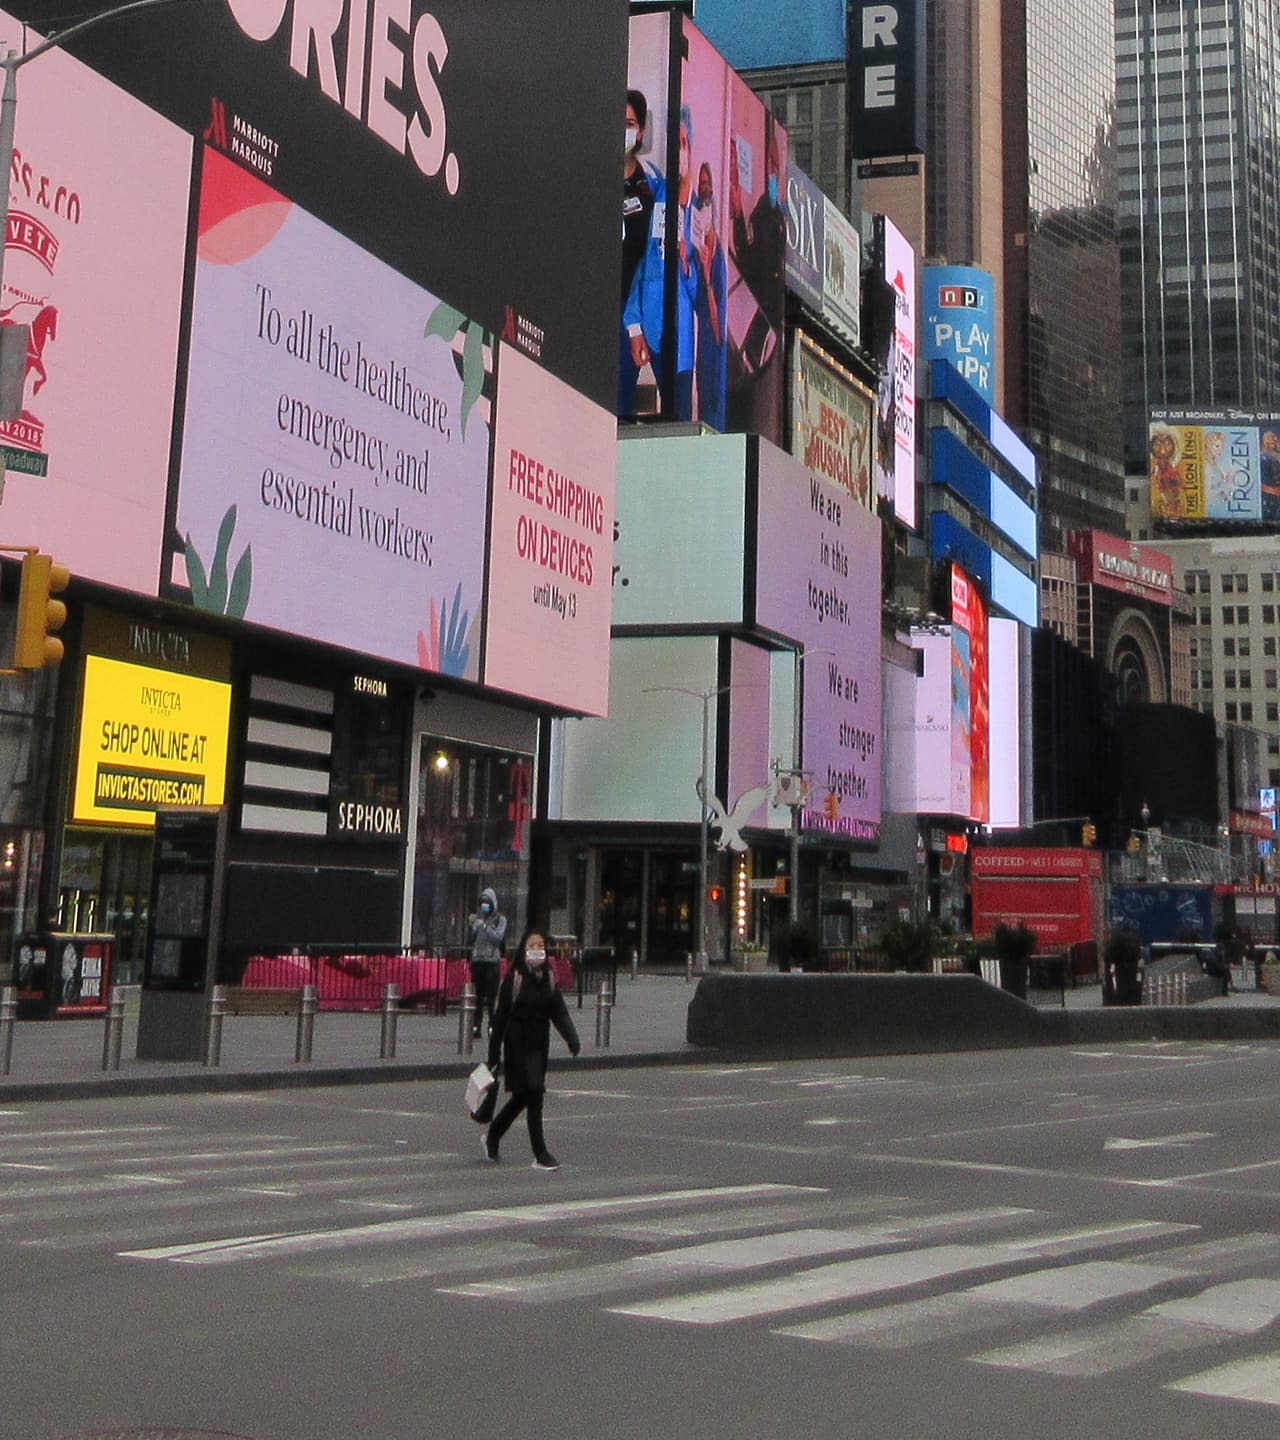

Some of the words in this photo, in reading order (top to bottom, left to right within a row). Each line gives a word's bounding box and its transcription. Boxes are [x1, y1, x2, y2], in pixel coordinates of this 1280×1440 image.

[232, 114, 280, 156] MARRIOTT
[231, 137, 274, 176] MARQUIS
[517, 315, 545, 342] MARRIOTT
[255, 283, 282, 346] To
[286, 309, 314, 364] all
[318, 325, 351, 384] the
[355, 340, 452, 442] healthcare,
[276, 393, 390, 488] emergency,
[394, 449, 430, 495] and
[820, 402, 847, 446] BEST
[0, 446, 46, 474] Broadway
[812, 436, 856, 495] MUSICAL
[1182, 430, 1198, 461] KING
[508, 447, 544, 506] FREE
[545, 467, 604, 534] SHIPPING
[1186, 462, 1200, 491] LION
[1228, 430, 1252, 514] FROZEN
[259, 466, 355, 537] essential
[357, 504, 434, 567] workers:
[809, 478, 825, 513] We
[826, 502, 842, 527] are
[1186, 491, 1199, 514] THE
[516, 514, 539, 561] ON
[539, 525, 594, 586] DEVICES
[819, 535, 830, 565] in
[831, 548, 849, 577] this
[532, 583, 552, 607] until
[551, 587, 568, 620] May
[568, 593, 578, 617] 13
[807, 582, 851, 626] together.
[128, 624, 191, 663] INVICTA
[140, 686, 182, 712] INVICTA
[352, 675, 388, 698] SEPHORA
[828, 663, 843, 693] We
[844, 680, 859, 703] are
[100, 719, 140, 754] SHOP
[141, 725, 190, 762] ONLINE
[190, 734, 208, 764] AT
[838, 721, 876, 762] stronger
[97, 772, 203, 806] INVICTASTORES.COM
[826, 762, 869, 803] together.
[337, 801, 402, 835] SEPHORA
[974, 855, 1025, 867] COFFEED
